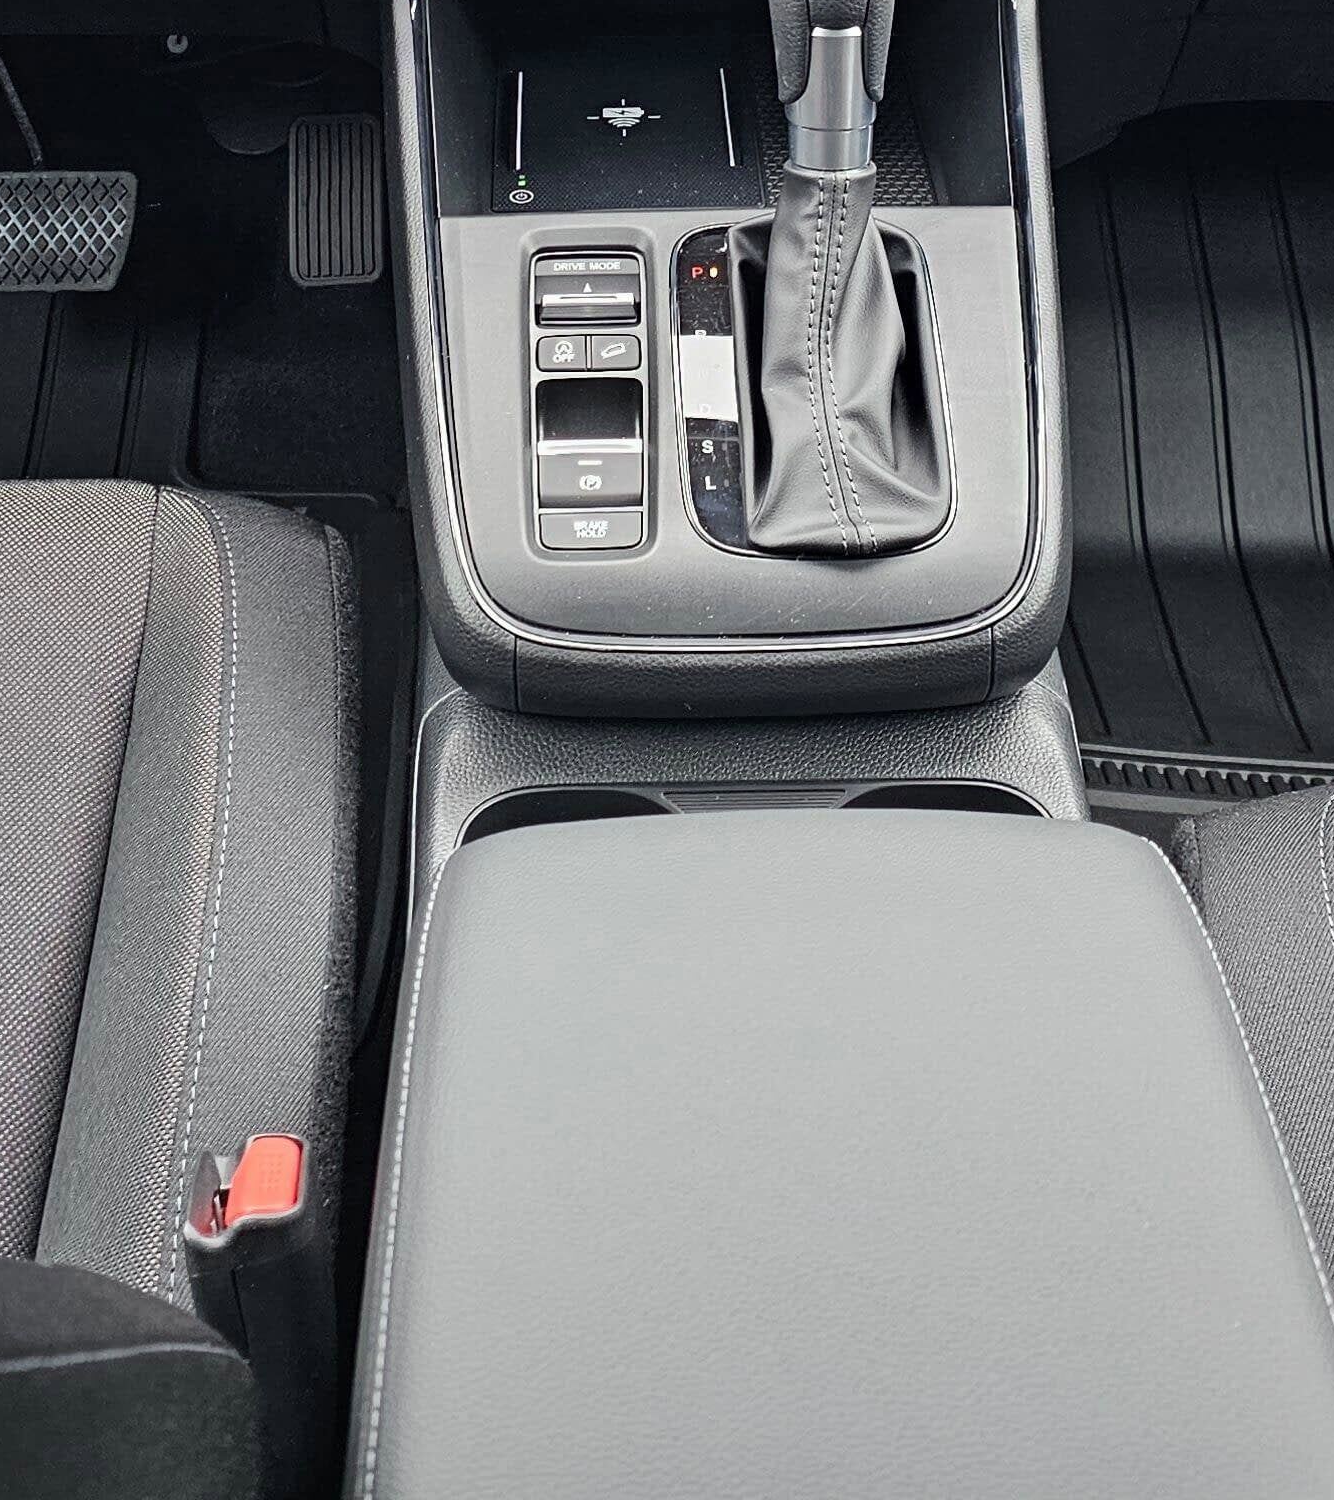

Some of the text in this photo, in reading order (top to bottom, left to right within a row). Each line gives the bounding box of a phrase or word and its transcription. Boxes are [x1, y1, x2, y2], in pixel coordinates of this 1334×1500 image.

[553, 261, 621, 272] DRIVE MODE
[691, 266, 704, 278] P
[552, 352, 576, 363] OFF
[701, 439, 714, 454] S
[704, 475, 717, 491] L
[573, 520, 609, 531] BRAKE
[576, 529, 607, 539] HOLD
